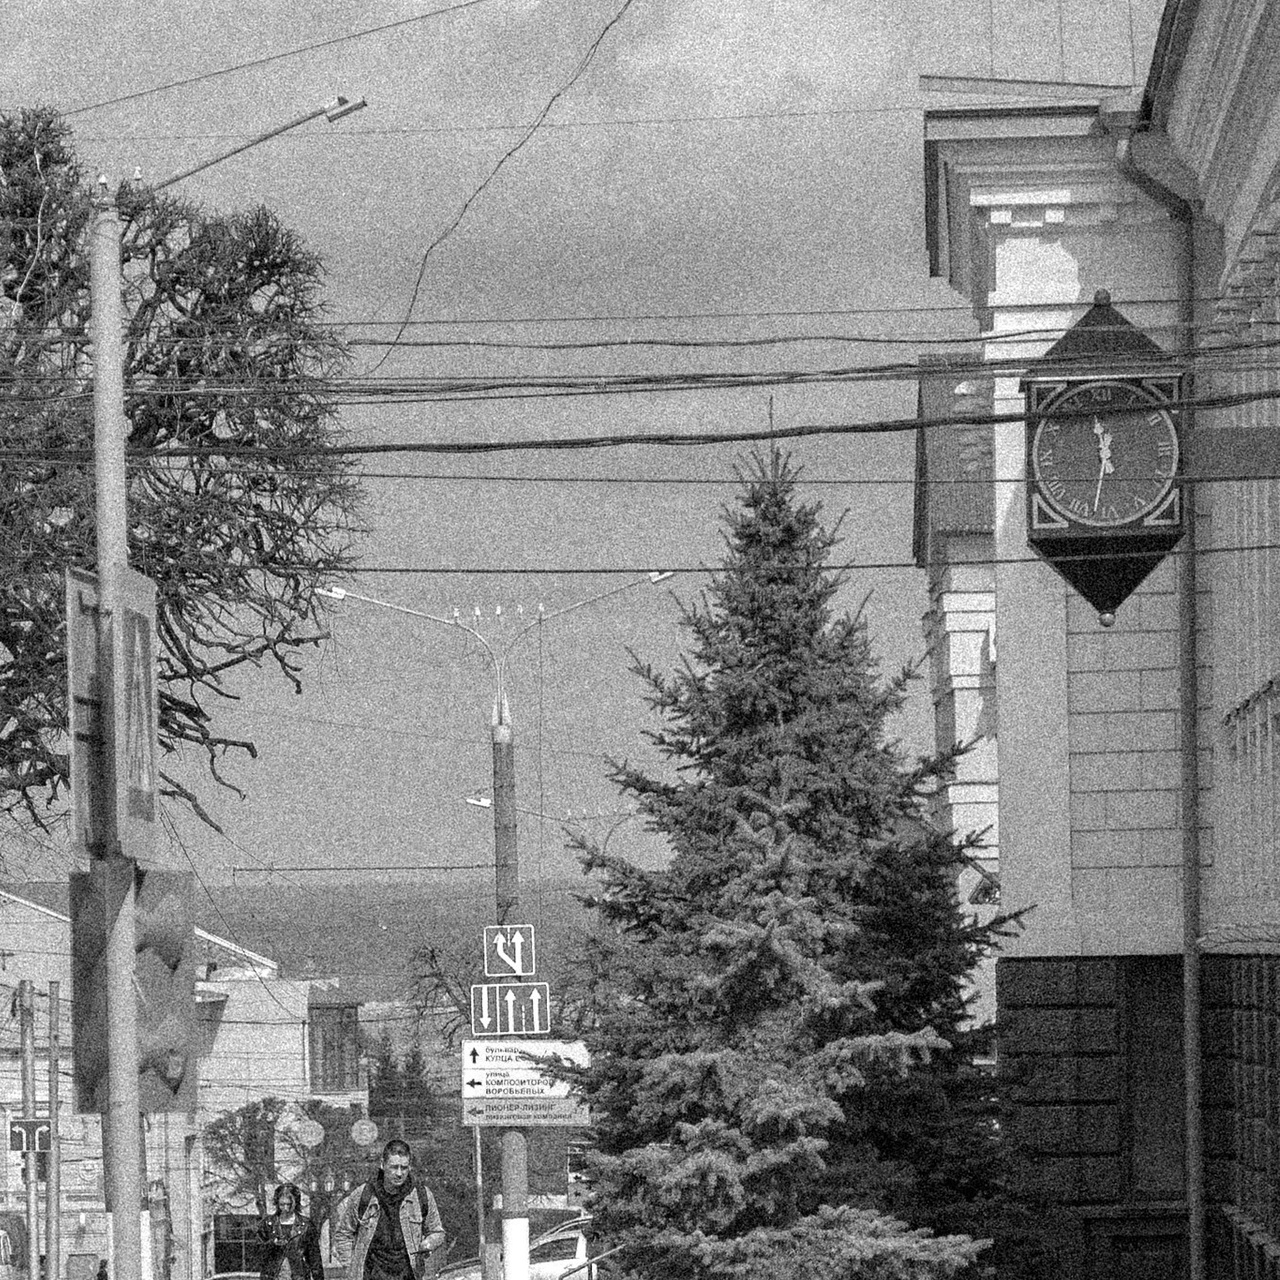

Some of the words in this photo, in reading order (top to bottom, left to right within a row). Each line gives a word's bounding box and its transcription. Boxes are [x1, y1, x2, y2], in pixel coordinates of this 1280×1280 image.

[1091, 388, 1112, 401] XII
[1147, 412, 1162, 426] II
[1044, 423, 1060, 436] X
[1157, 441, 1173, 457] III
[1040, 449, 1053, 466] IX
[1046, 475, 1066, 500] VIII
[1069, 499, 1089, 517] VII
[1132, 496, 1146, 509] V
[1102, 505, 1120, 519] VI
[485, 1055, 513, 1063] КУПЦА
